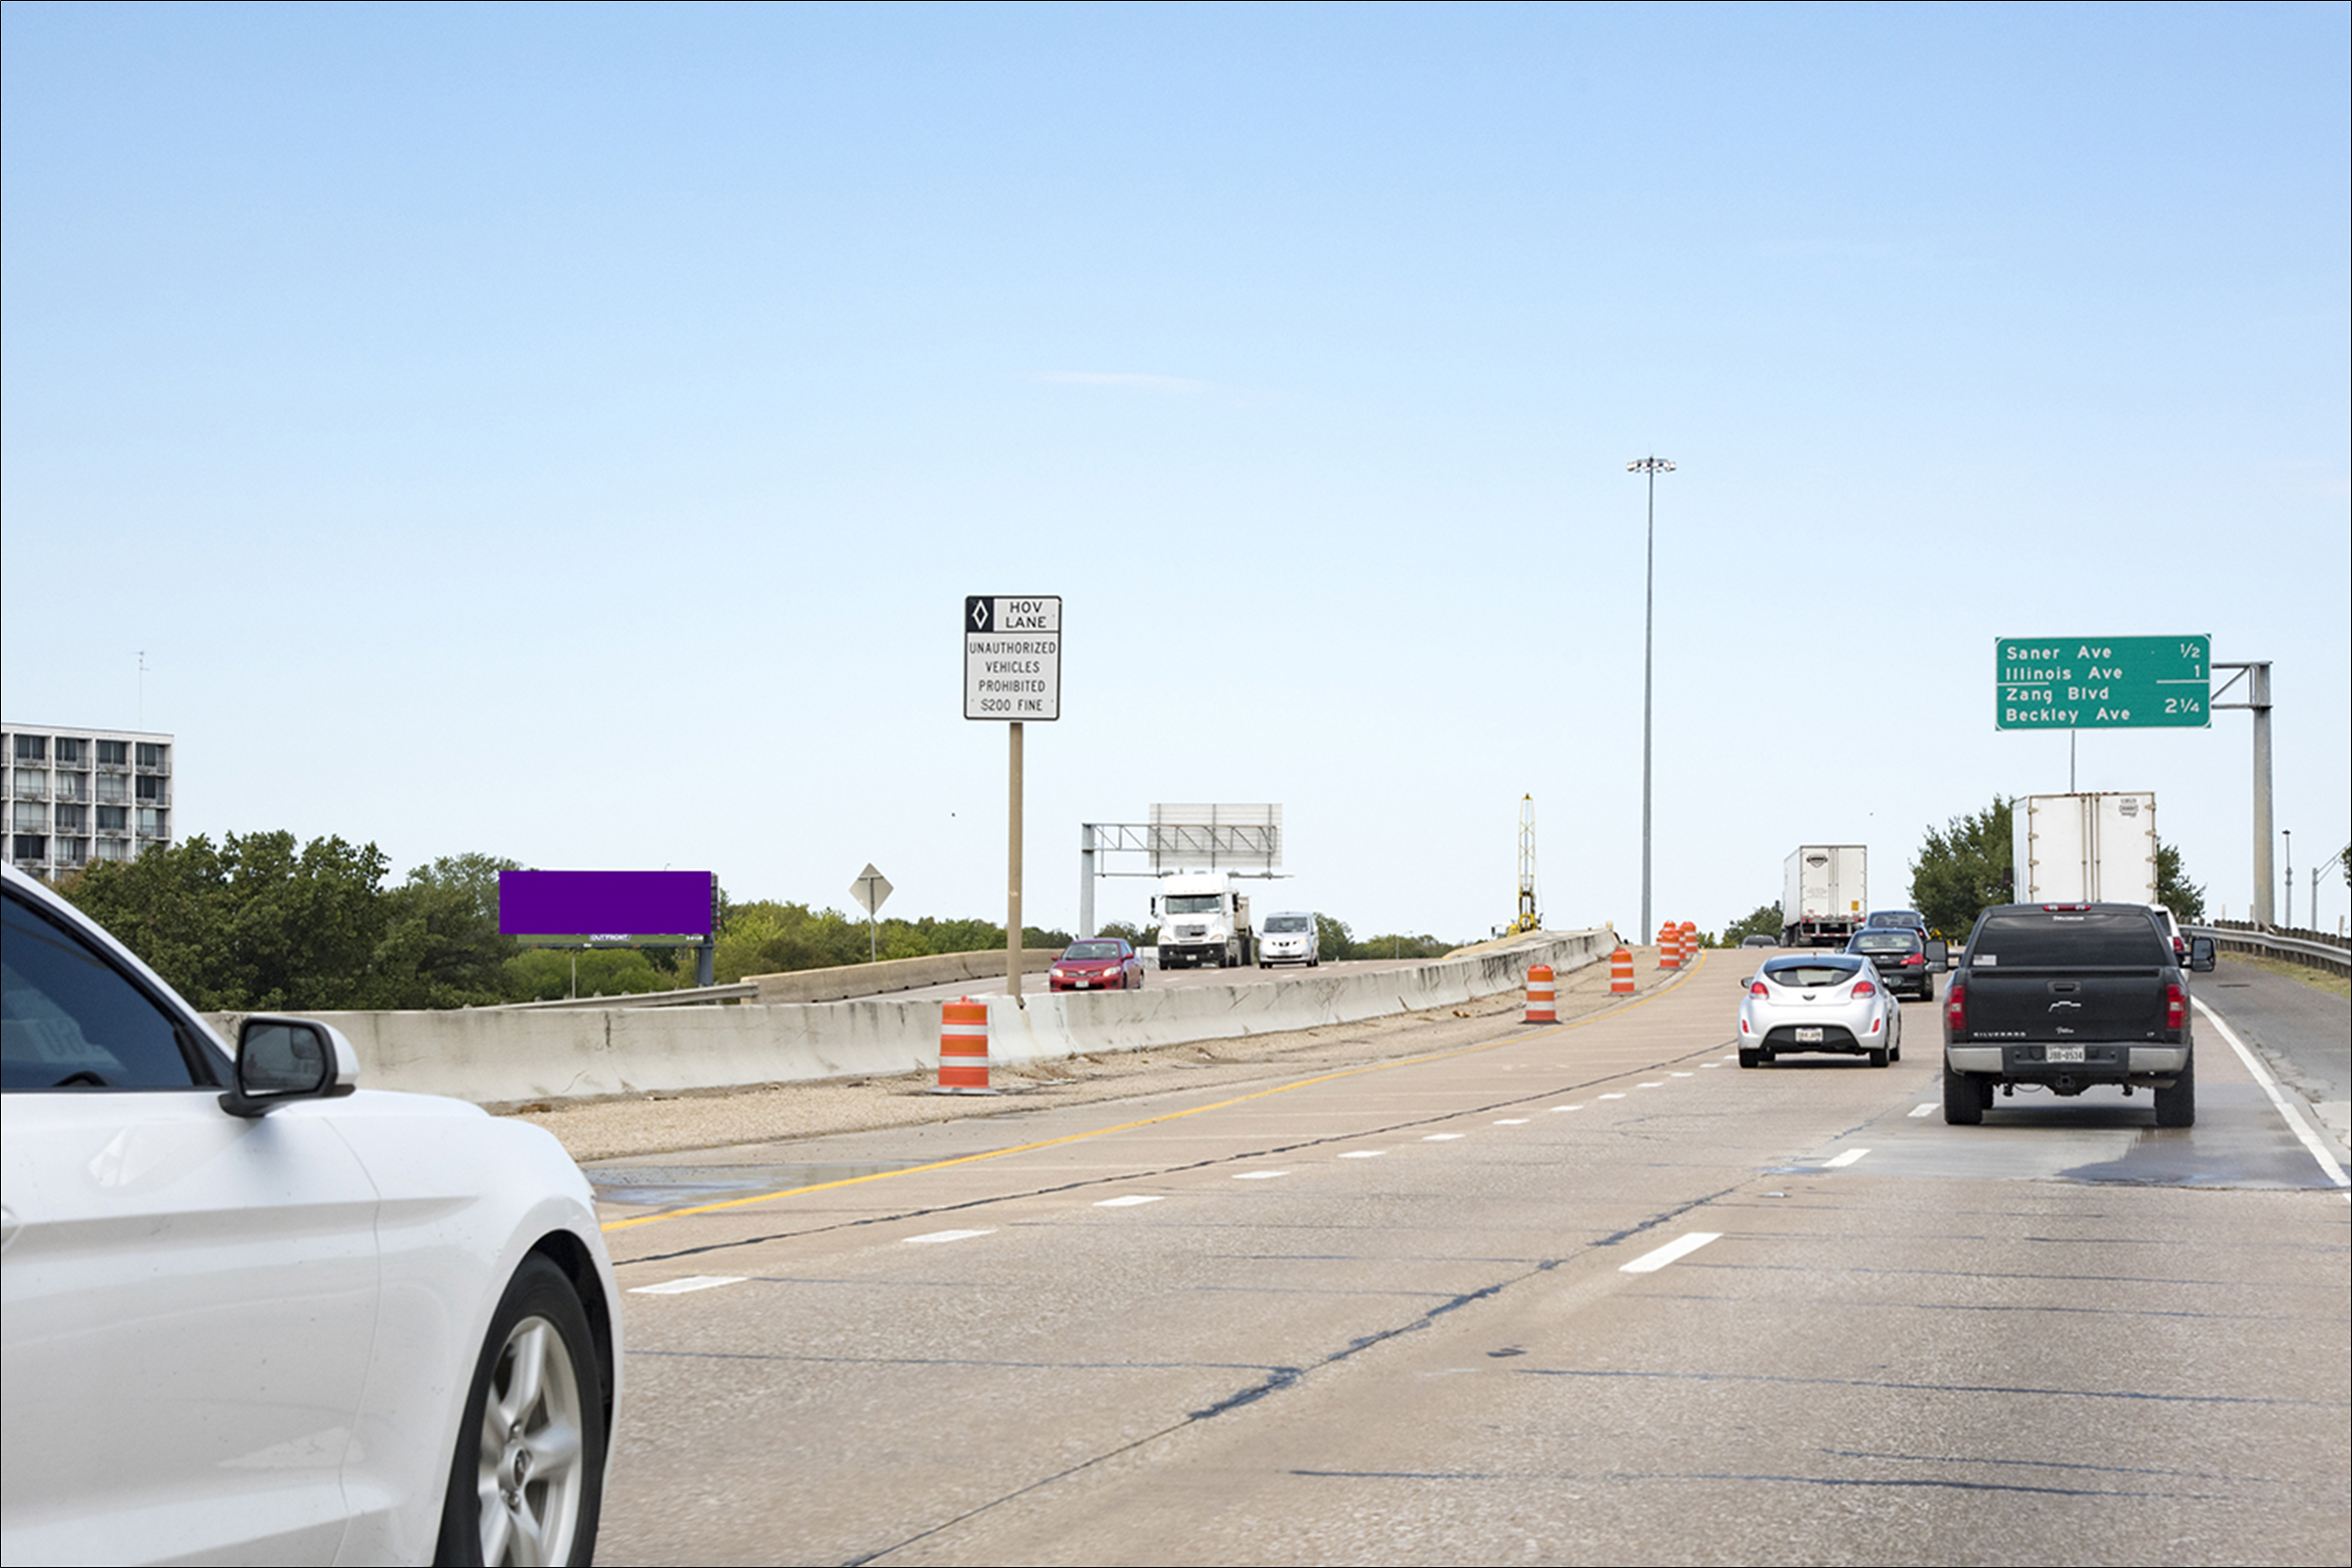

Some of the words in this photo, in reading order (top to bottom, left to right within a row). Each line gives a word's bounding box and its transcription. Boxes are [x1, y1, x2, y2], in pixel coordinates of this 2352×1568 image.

[1009, 601, 1044, 614] HOV
[1005, 616, 1048, 628] LANE
[969, 642, 1056, 655] UNAUTHORIZED
[2006, 646, 2060, 661] Saner
[2077, 645, 2113, 660] Ave
[985, 661, 1041, 674] VEHICLES
[2005, 666, 2072, 681] Illinois
[2087, 665, 2124, 679] Ave
[2194, 664, 2200, 678] 1
[978, 679, 1046, 693] PROHIBITED
[2006, 687, 2053, 705] Zang
[2068, 687, 2110, 701] Blvd
[1017, 699, 1044, 711] FINE
[2006, 708, 2080, 724] Beckley
[2095, 707, 2132, 720] Ave
